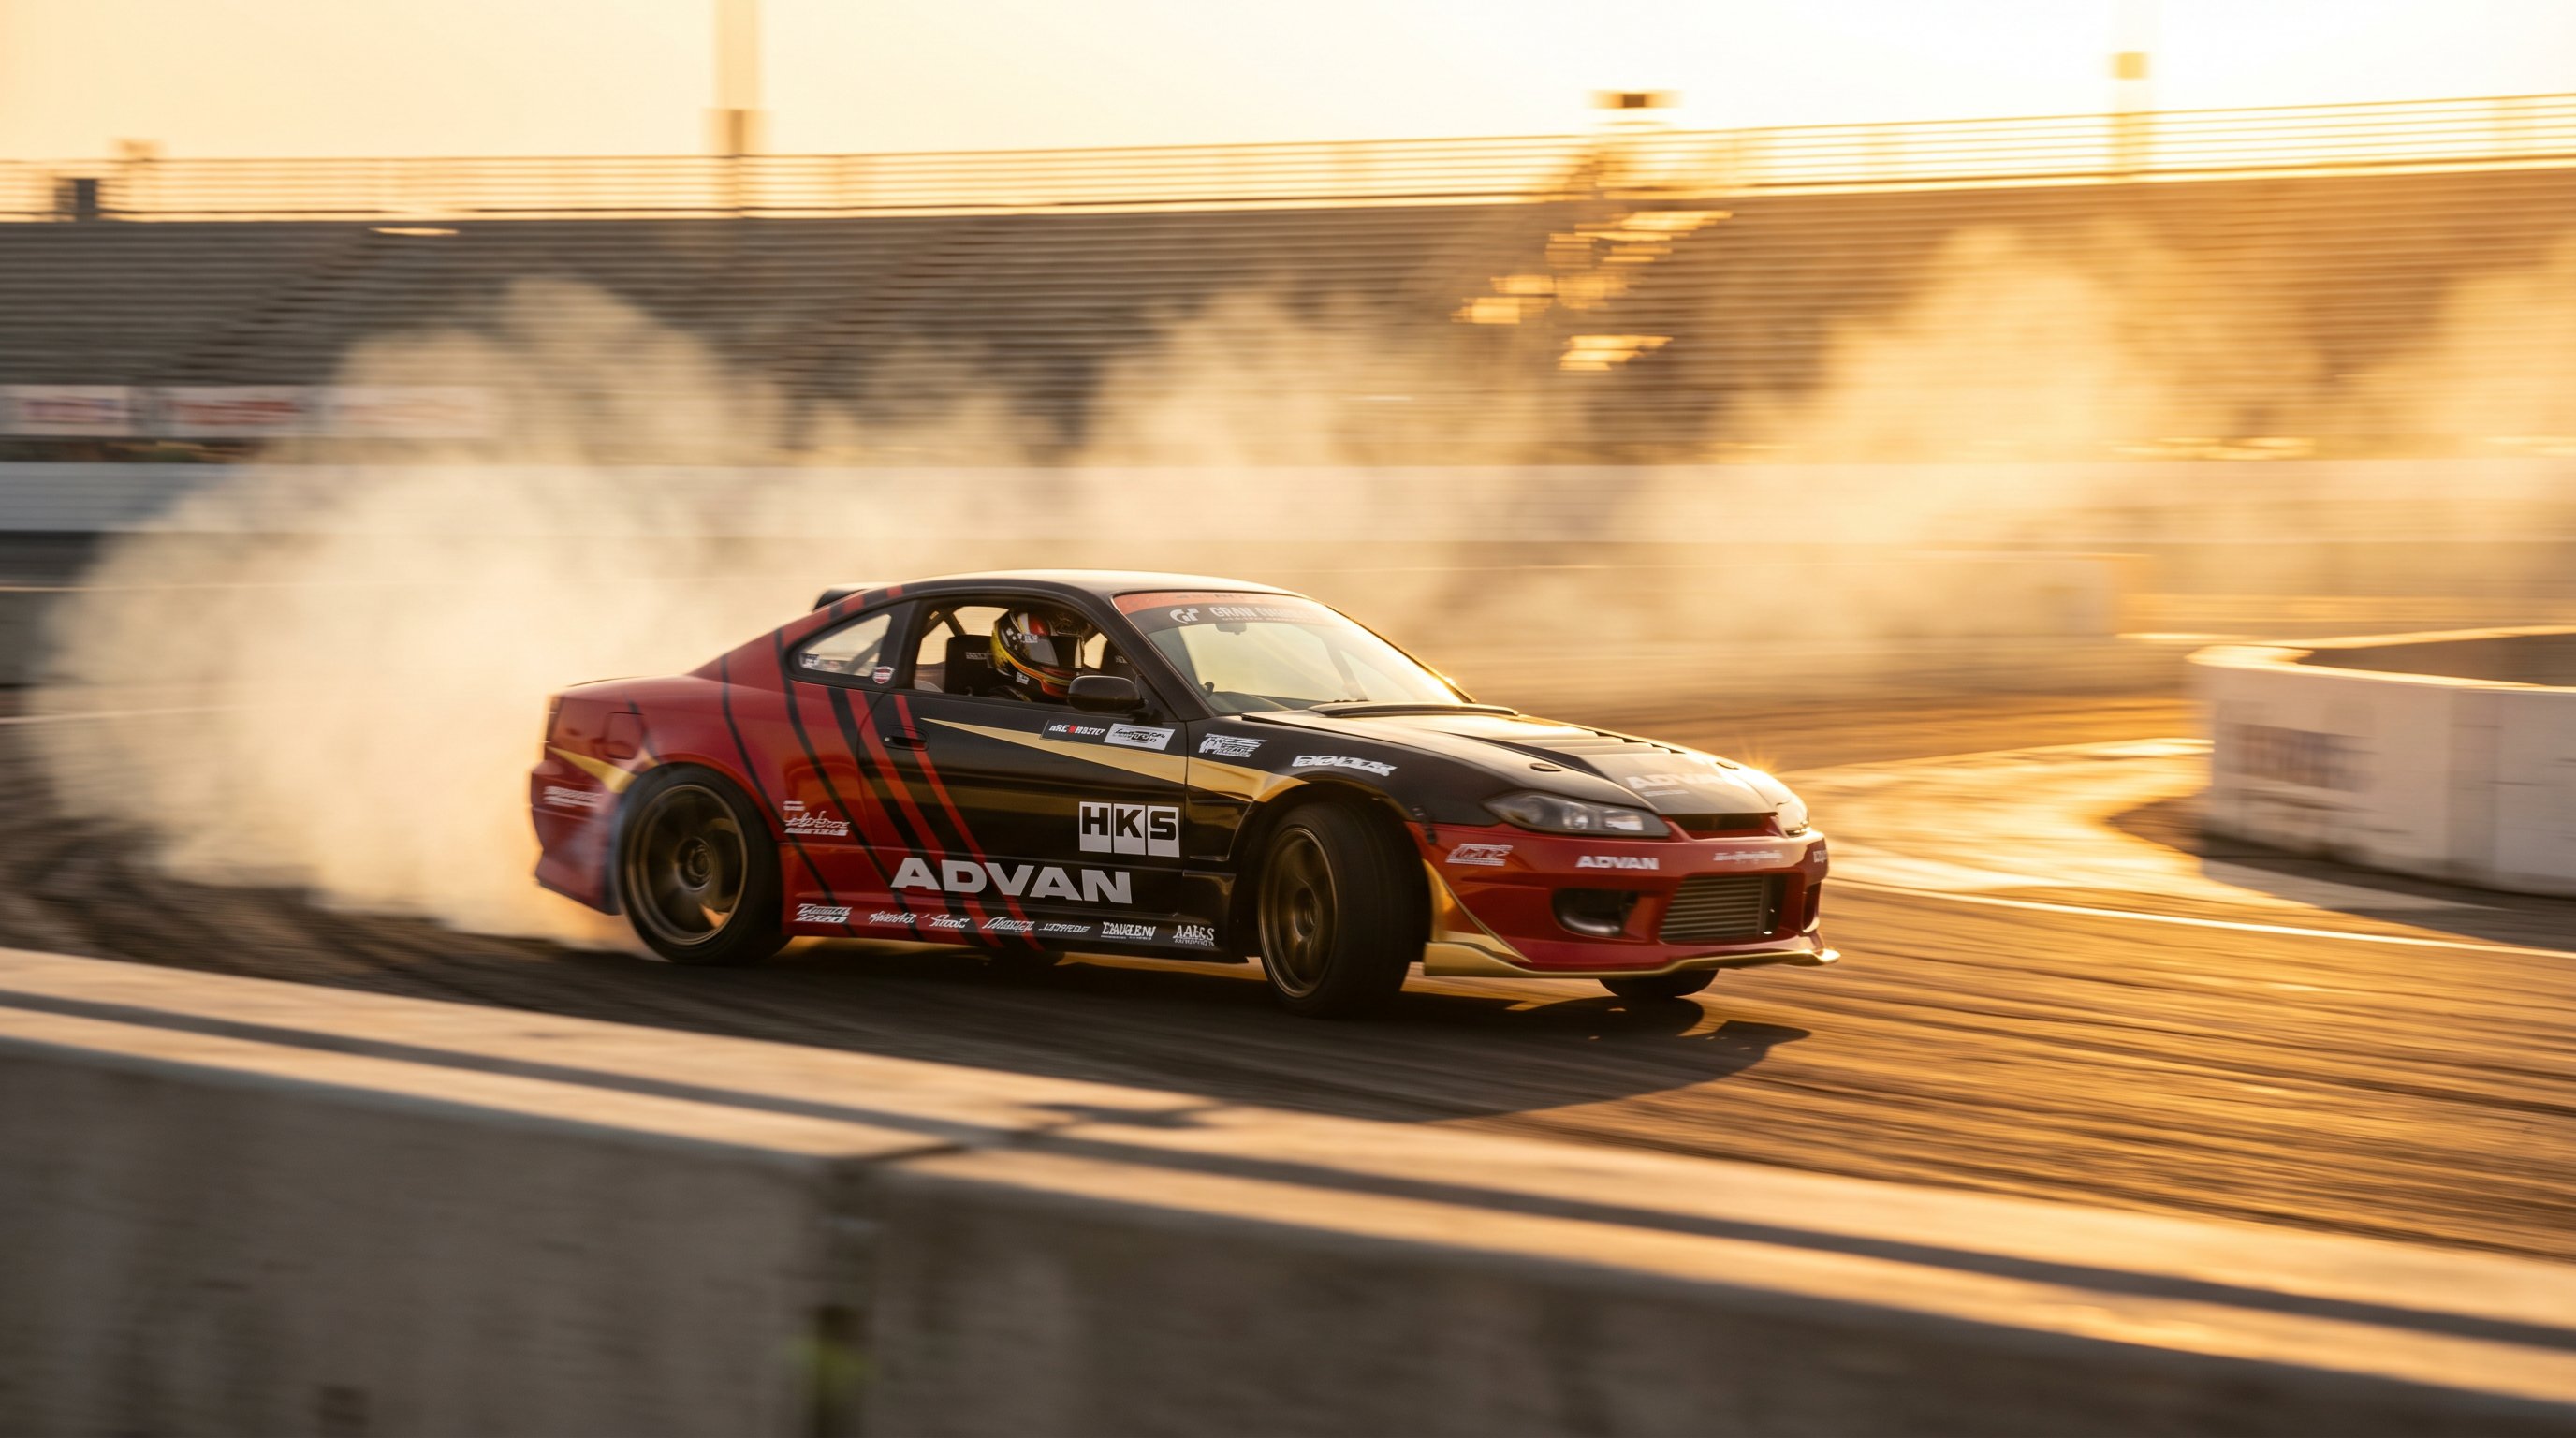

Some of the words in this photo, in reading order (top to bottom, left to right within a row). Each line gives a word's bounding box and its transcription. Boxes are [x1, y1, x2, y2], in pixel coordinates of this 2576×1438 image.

[1080, 804, 1178, 844] HKS
[890, 857, 1133, 904] ADVAN
[1576, 855, 1661, 871] ADVAN
